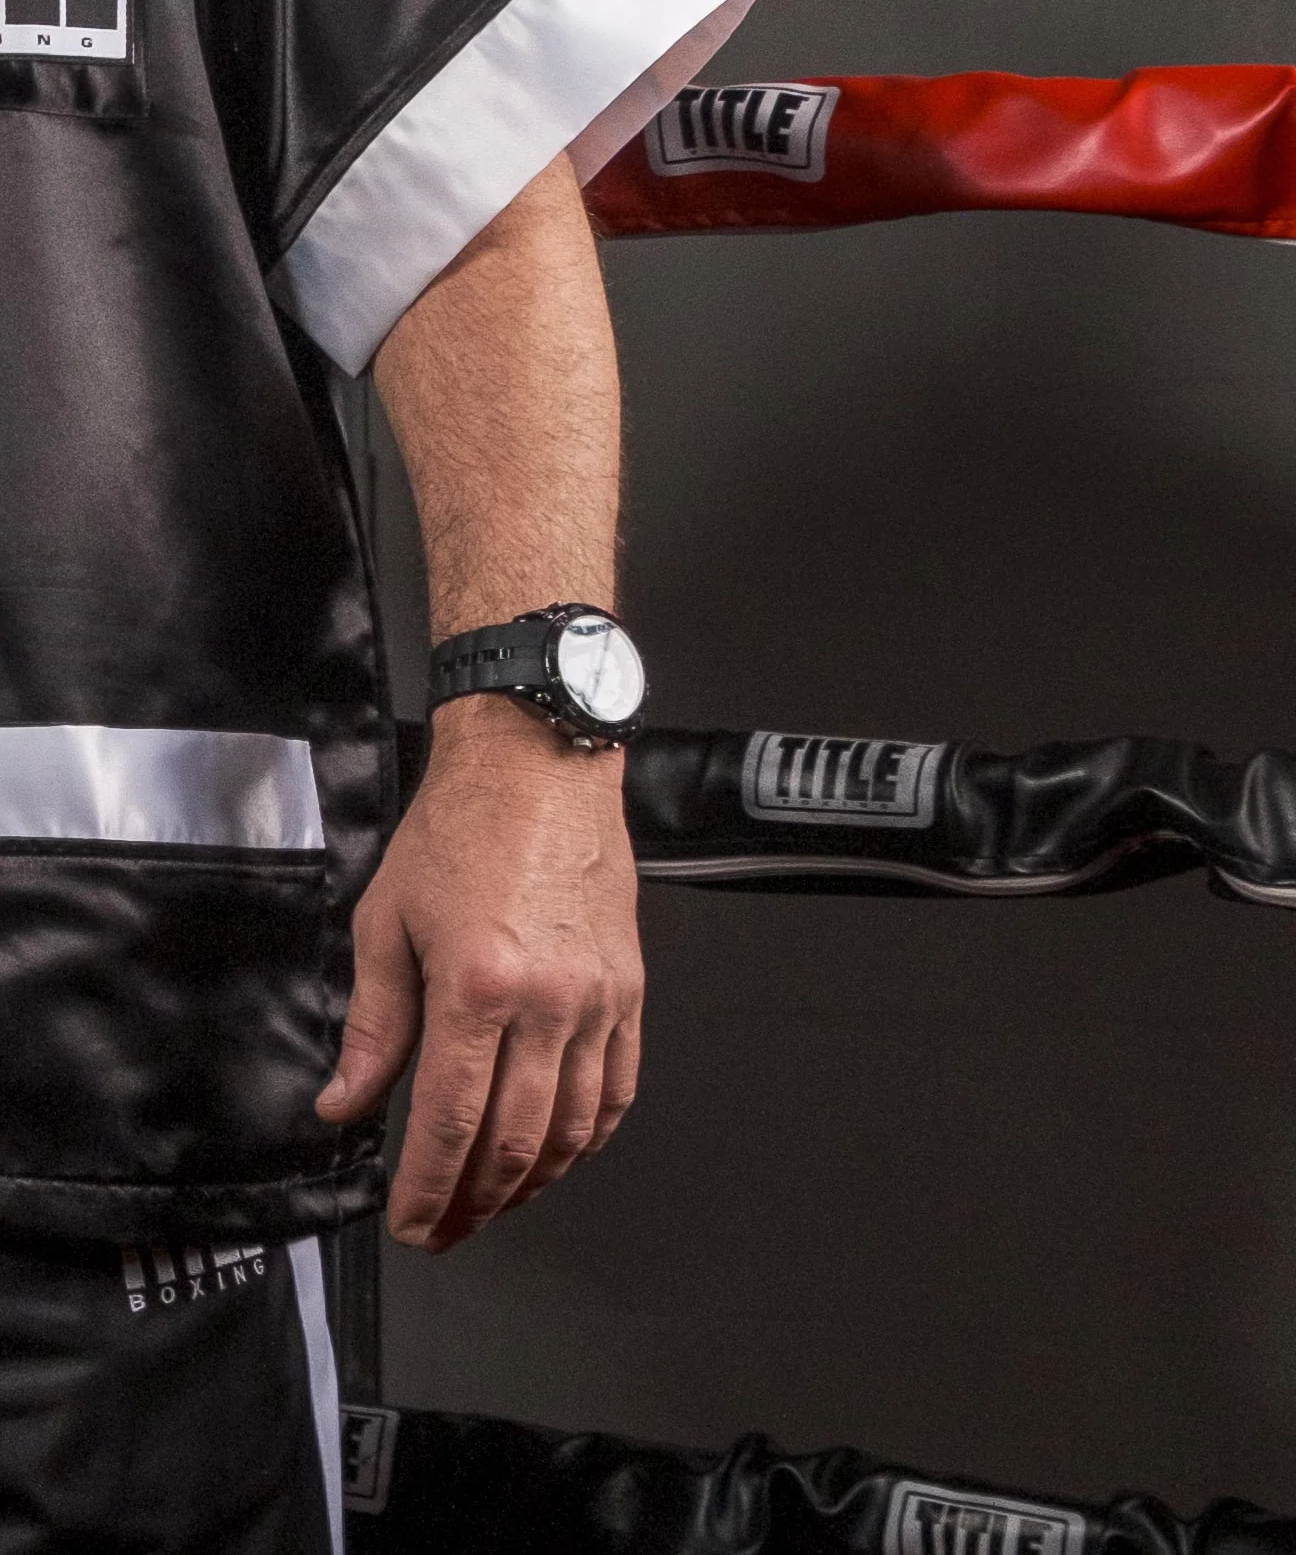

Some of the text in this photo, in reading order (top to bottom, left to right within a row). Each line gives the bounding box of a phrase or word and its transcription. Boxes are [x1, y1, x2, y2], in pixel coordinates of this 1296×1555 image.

[674, 88, 809, 155] TITLE
[775, 736, 908, 803] TITLE
[128, 1258, 266, 1312] BOXING
